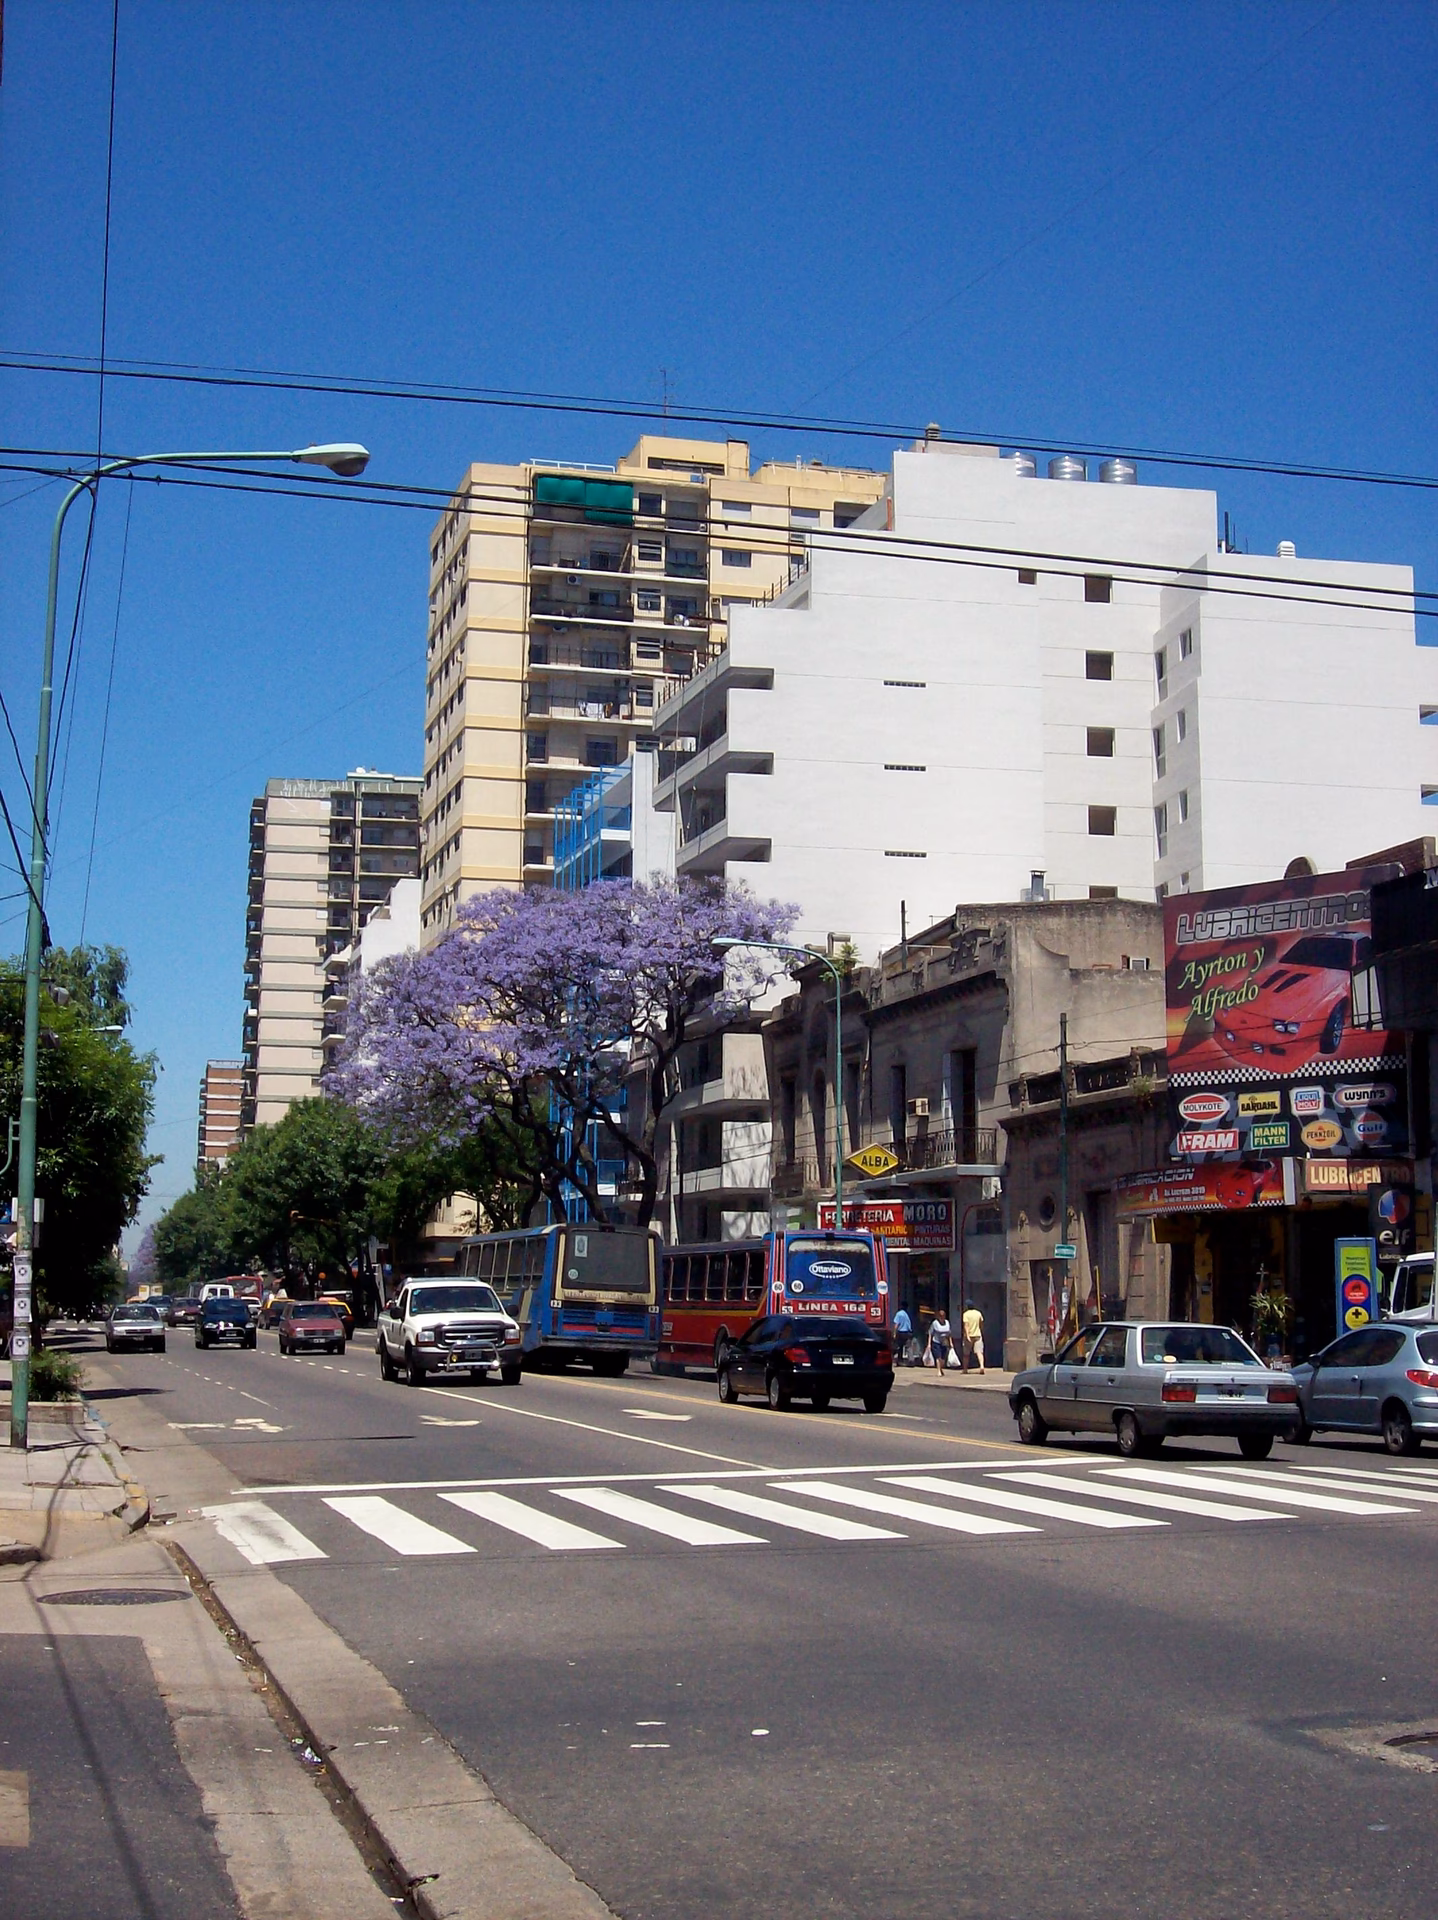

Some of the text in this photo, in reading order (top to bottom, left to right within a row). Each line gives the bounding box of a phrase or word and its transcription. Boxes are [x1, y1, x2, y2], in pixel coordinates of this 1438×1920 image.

[1177, 946, 1266, 990] Ayrton y
[1184, 978, 1260, 1023] Alfredo
[1182, 1102, 1222, 1113] MOLYKOTE
[1240, 1101, 1279, 1113] BARDAHL
[1254, 1126, 1287, 1137] MANN
[1181, 1132, 1235, 1150] FRAM
[1254, 1136, 1287, 1146] FILTER
[860, 1155, 890, 1168] ALBA
[825, 1203, 947, 1224] FERRETERIA MORO
[1379, 1228, 1410, 1245] elf
[811, 1264, 849, 1274] Ottaviano
[774, 1283, 783, 1292] 60
